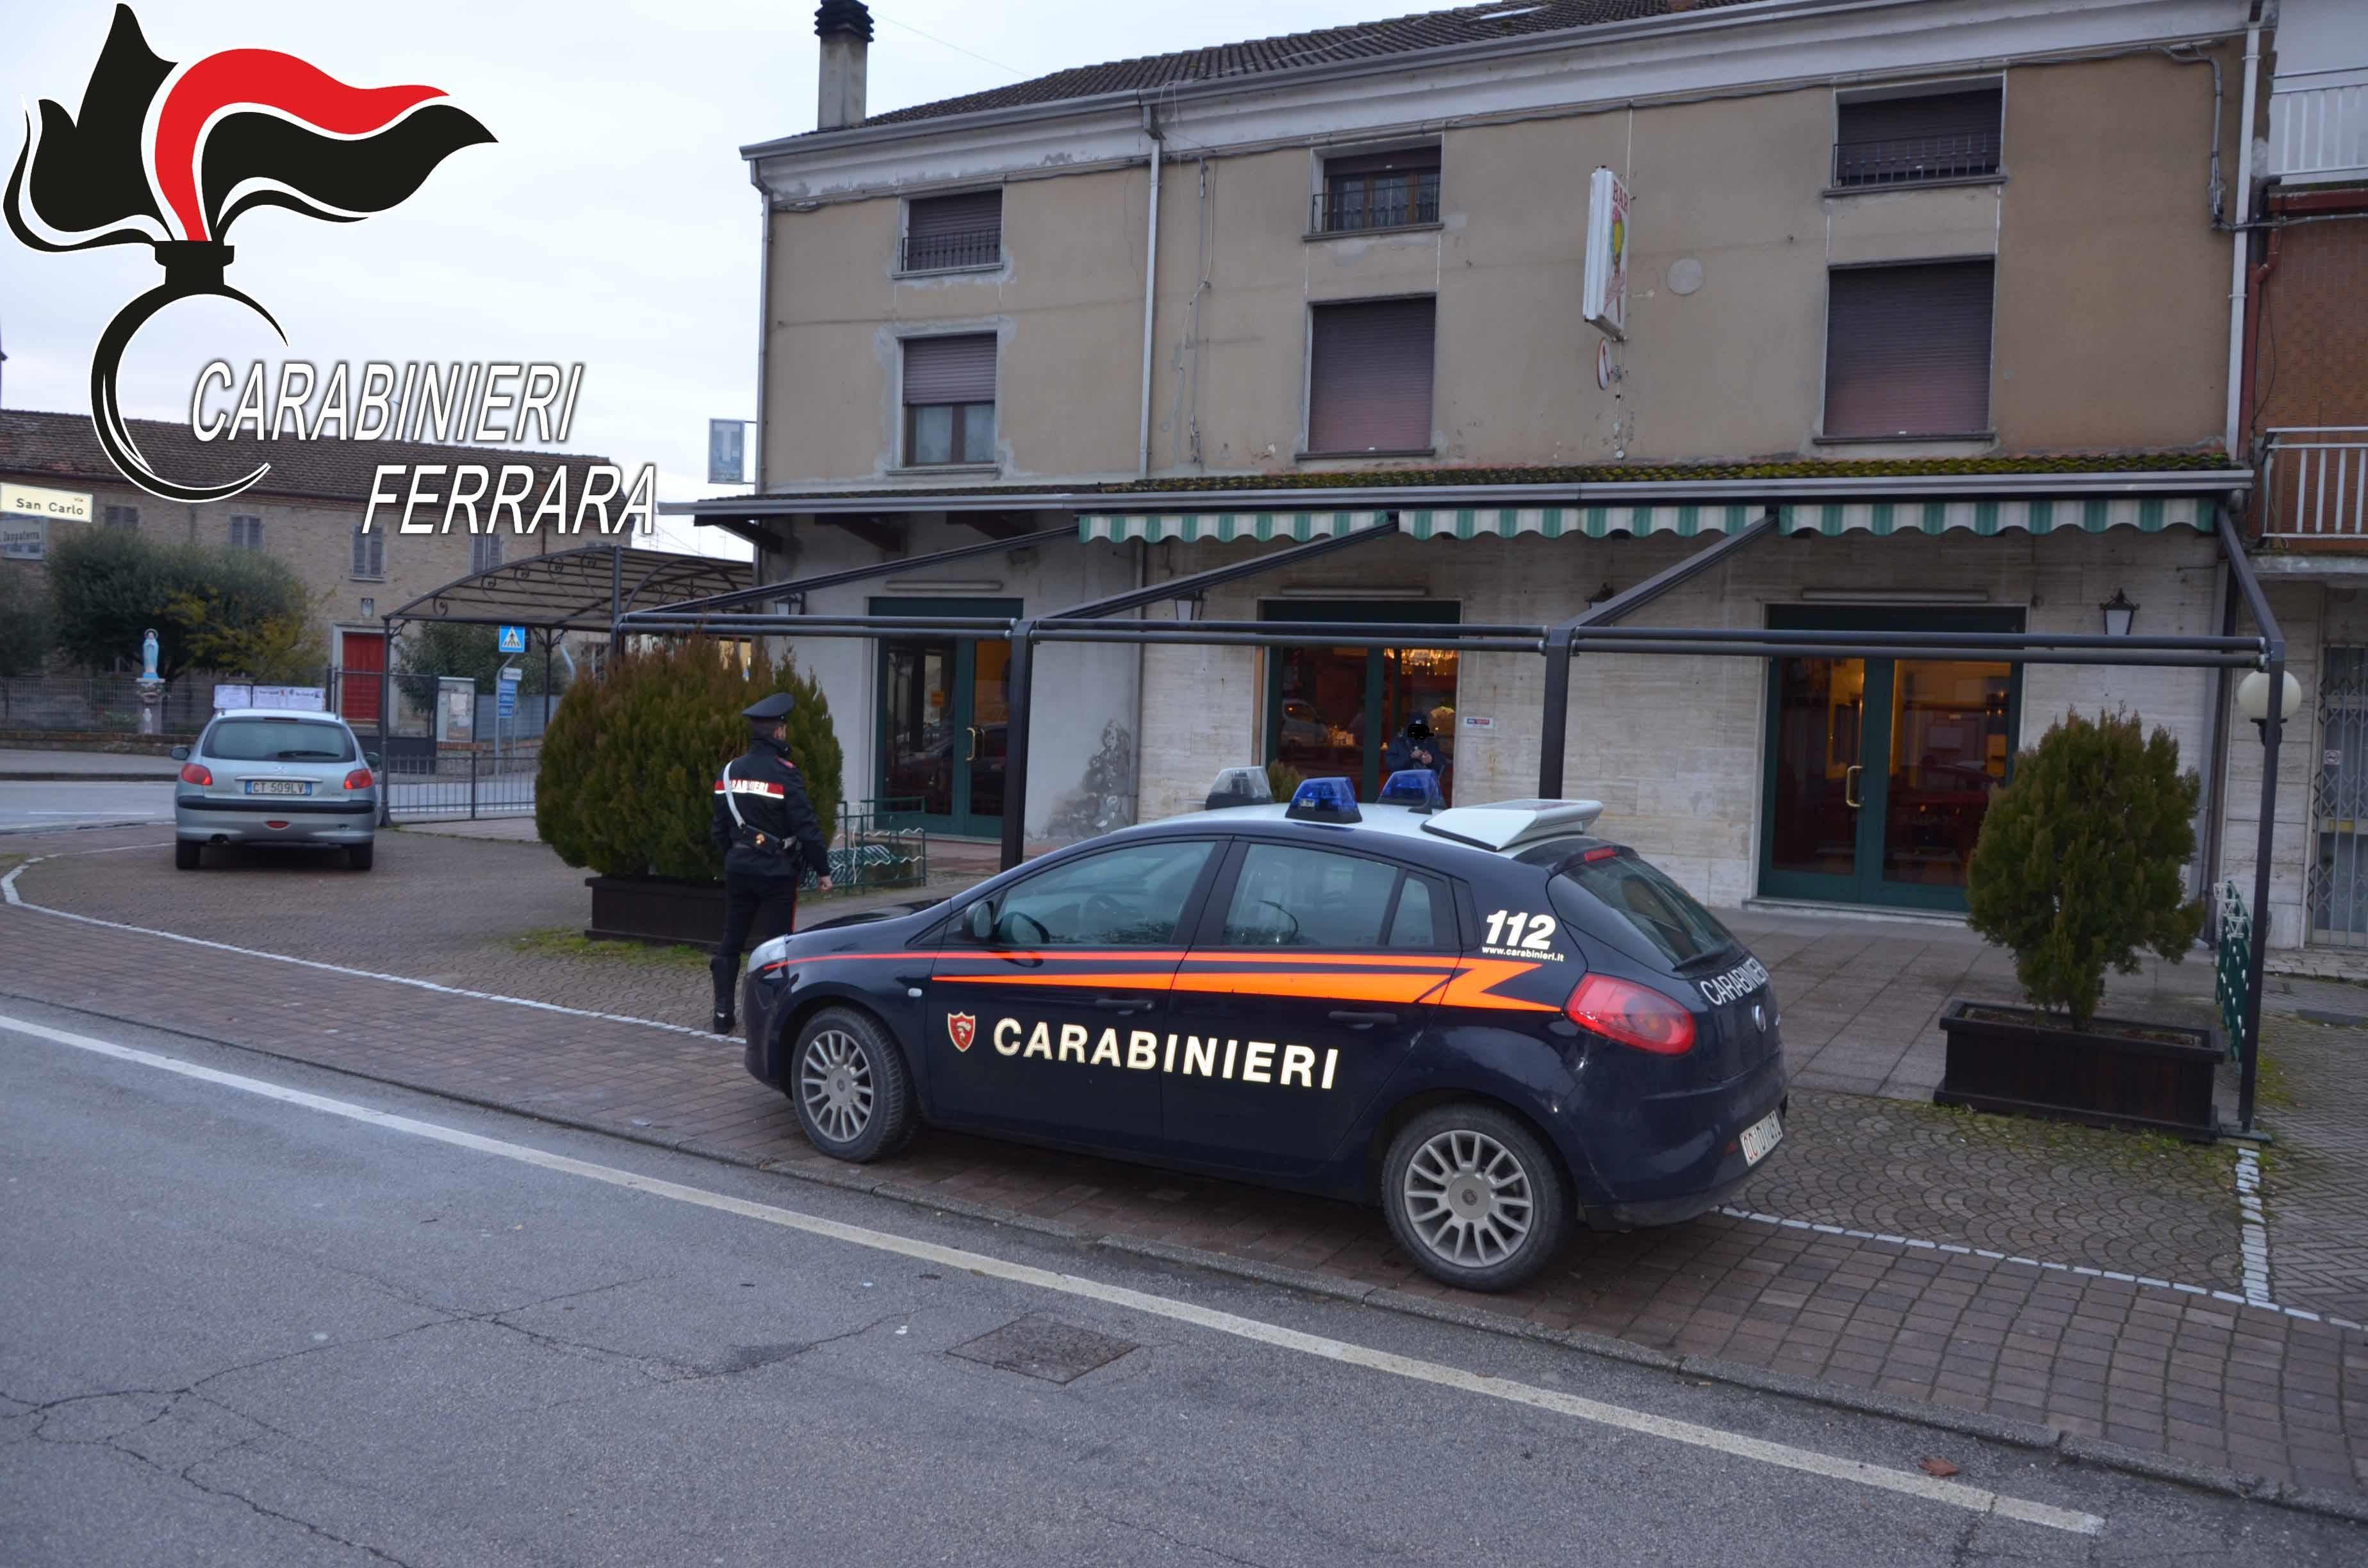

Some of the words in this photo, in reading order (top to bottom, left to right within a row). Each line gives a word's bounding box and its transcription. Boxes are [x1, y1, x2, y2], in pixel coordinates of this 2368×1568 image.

[1613, 180, 1628, 213] BAR
[16, 498, 41, 510] San
[48, 502, 84, 516] Carlo
[253, 782, 267, 793] CT
[1486, 910, 1556, 950] 112
[1481, 946, 1565, 962] www.carabinieri.it
[994, 1017, 1338, 1090] CARABINIERI
